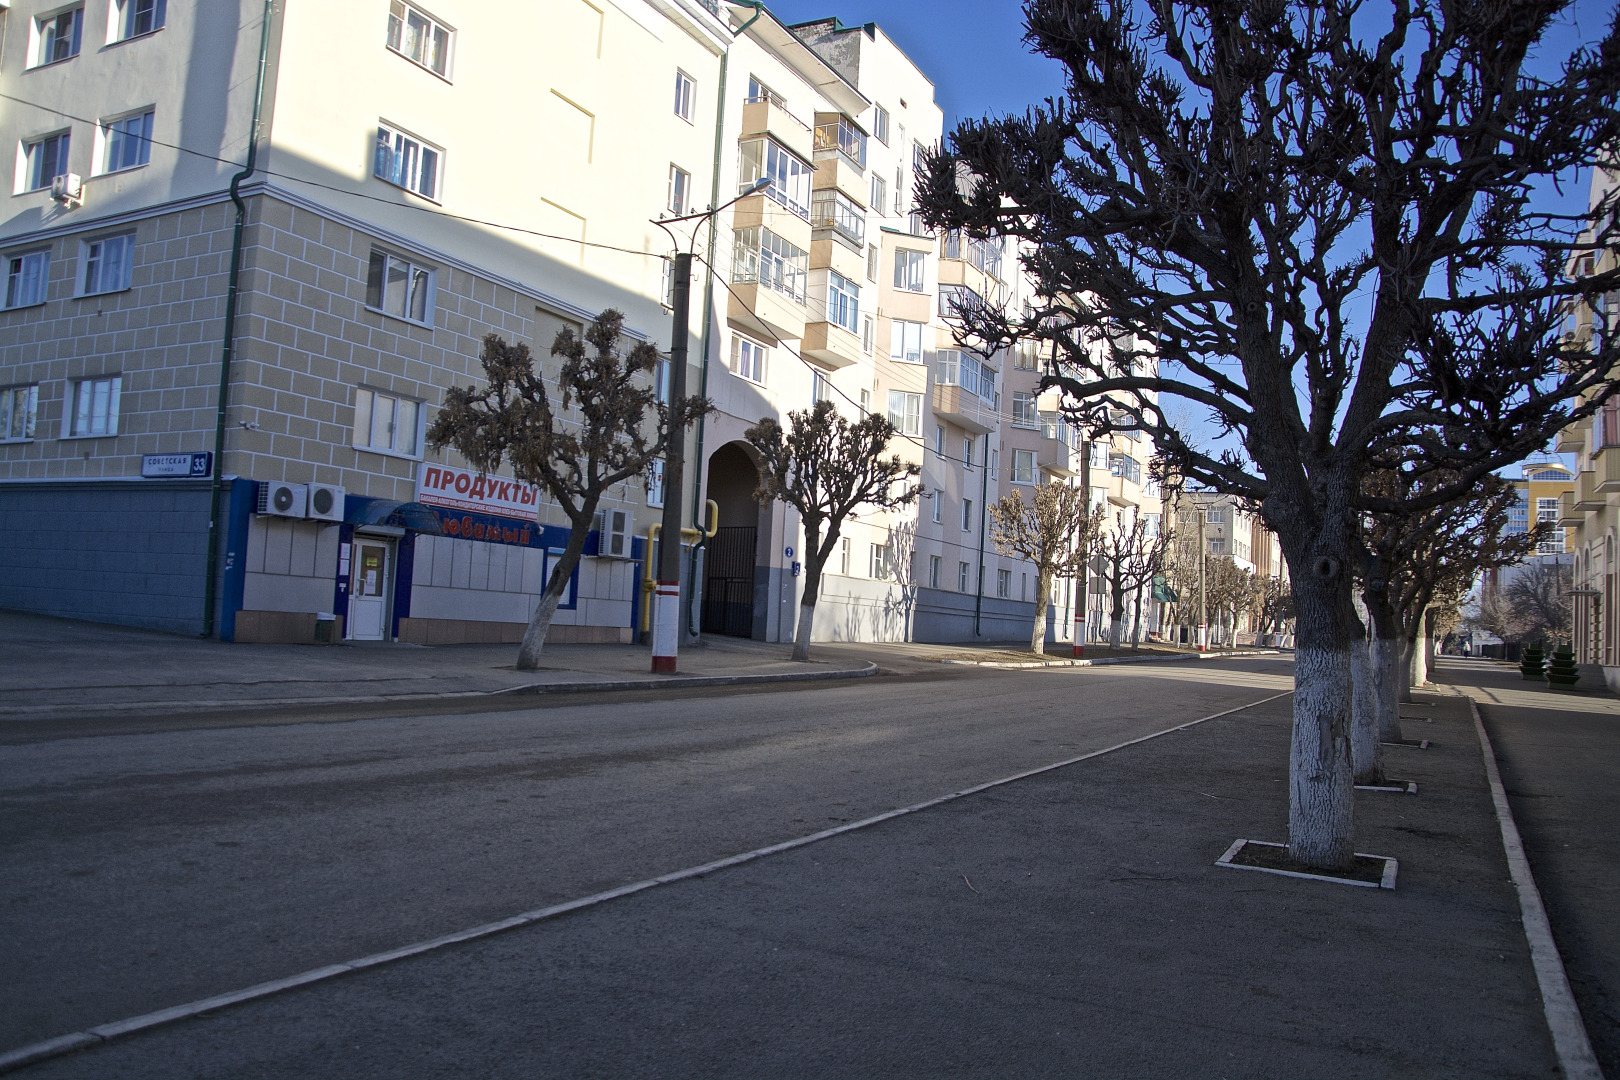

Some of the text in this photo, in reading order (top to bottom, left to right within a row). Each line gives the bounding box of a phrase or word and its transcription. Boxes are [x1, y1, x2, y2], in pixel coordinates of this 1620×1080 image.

[148, 457, 187, 465] СОВЕТСКАЯ
[193, 458, 205, 471] 33
[424, 467, 538, 506] ПРОДУКТЫ
